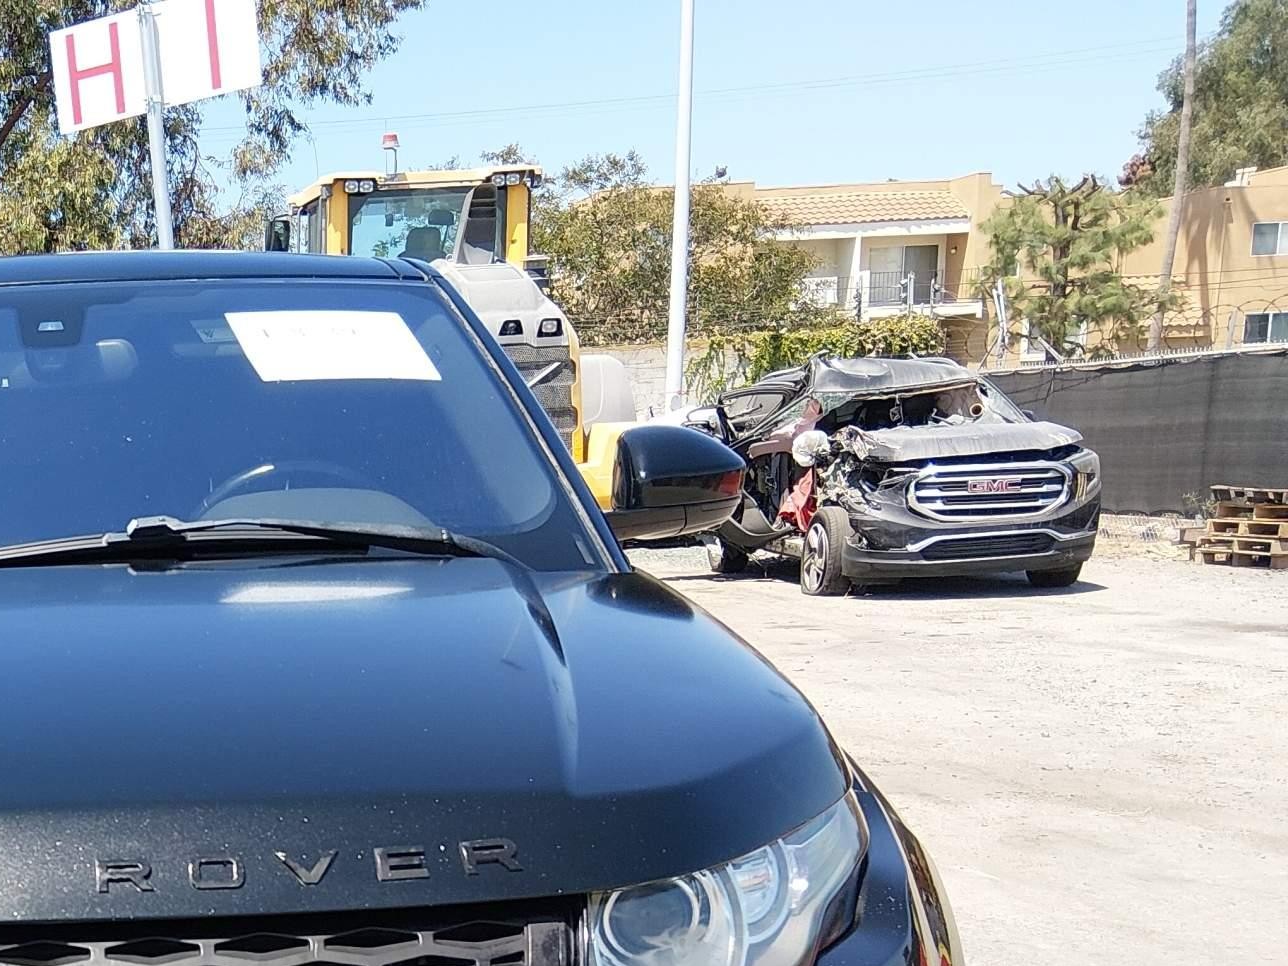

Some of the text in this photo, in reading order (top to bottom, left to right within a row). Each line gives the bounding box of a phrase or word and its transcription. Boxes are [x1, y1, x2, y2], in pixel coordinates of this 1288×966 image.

[65, 22, 126, 125] H
[968, 478, 1022, 494] GMC
[94, 838, 523, 894] ROVER
